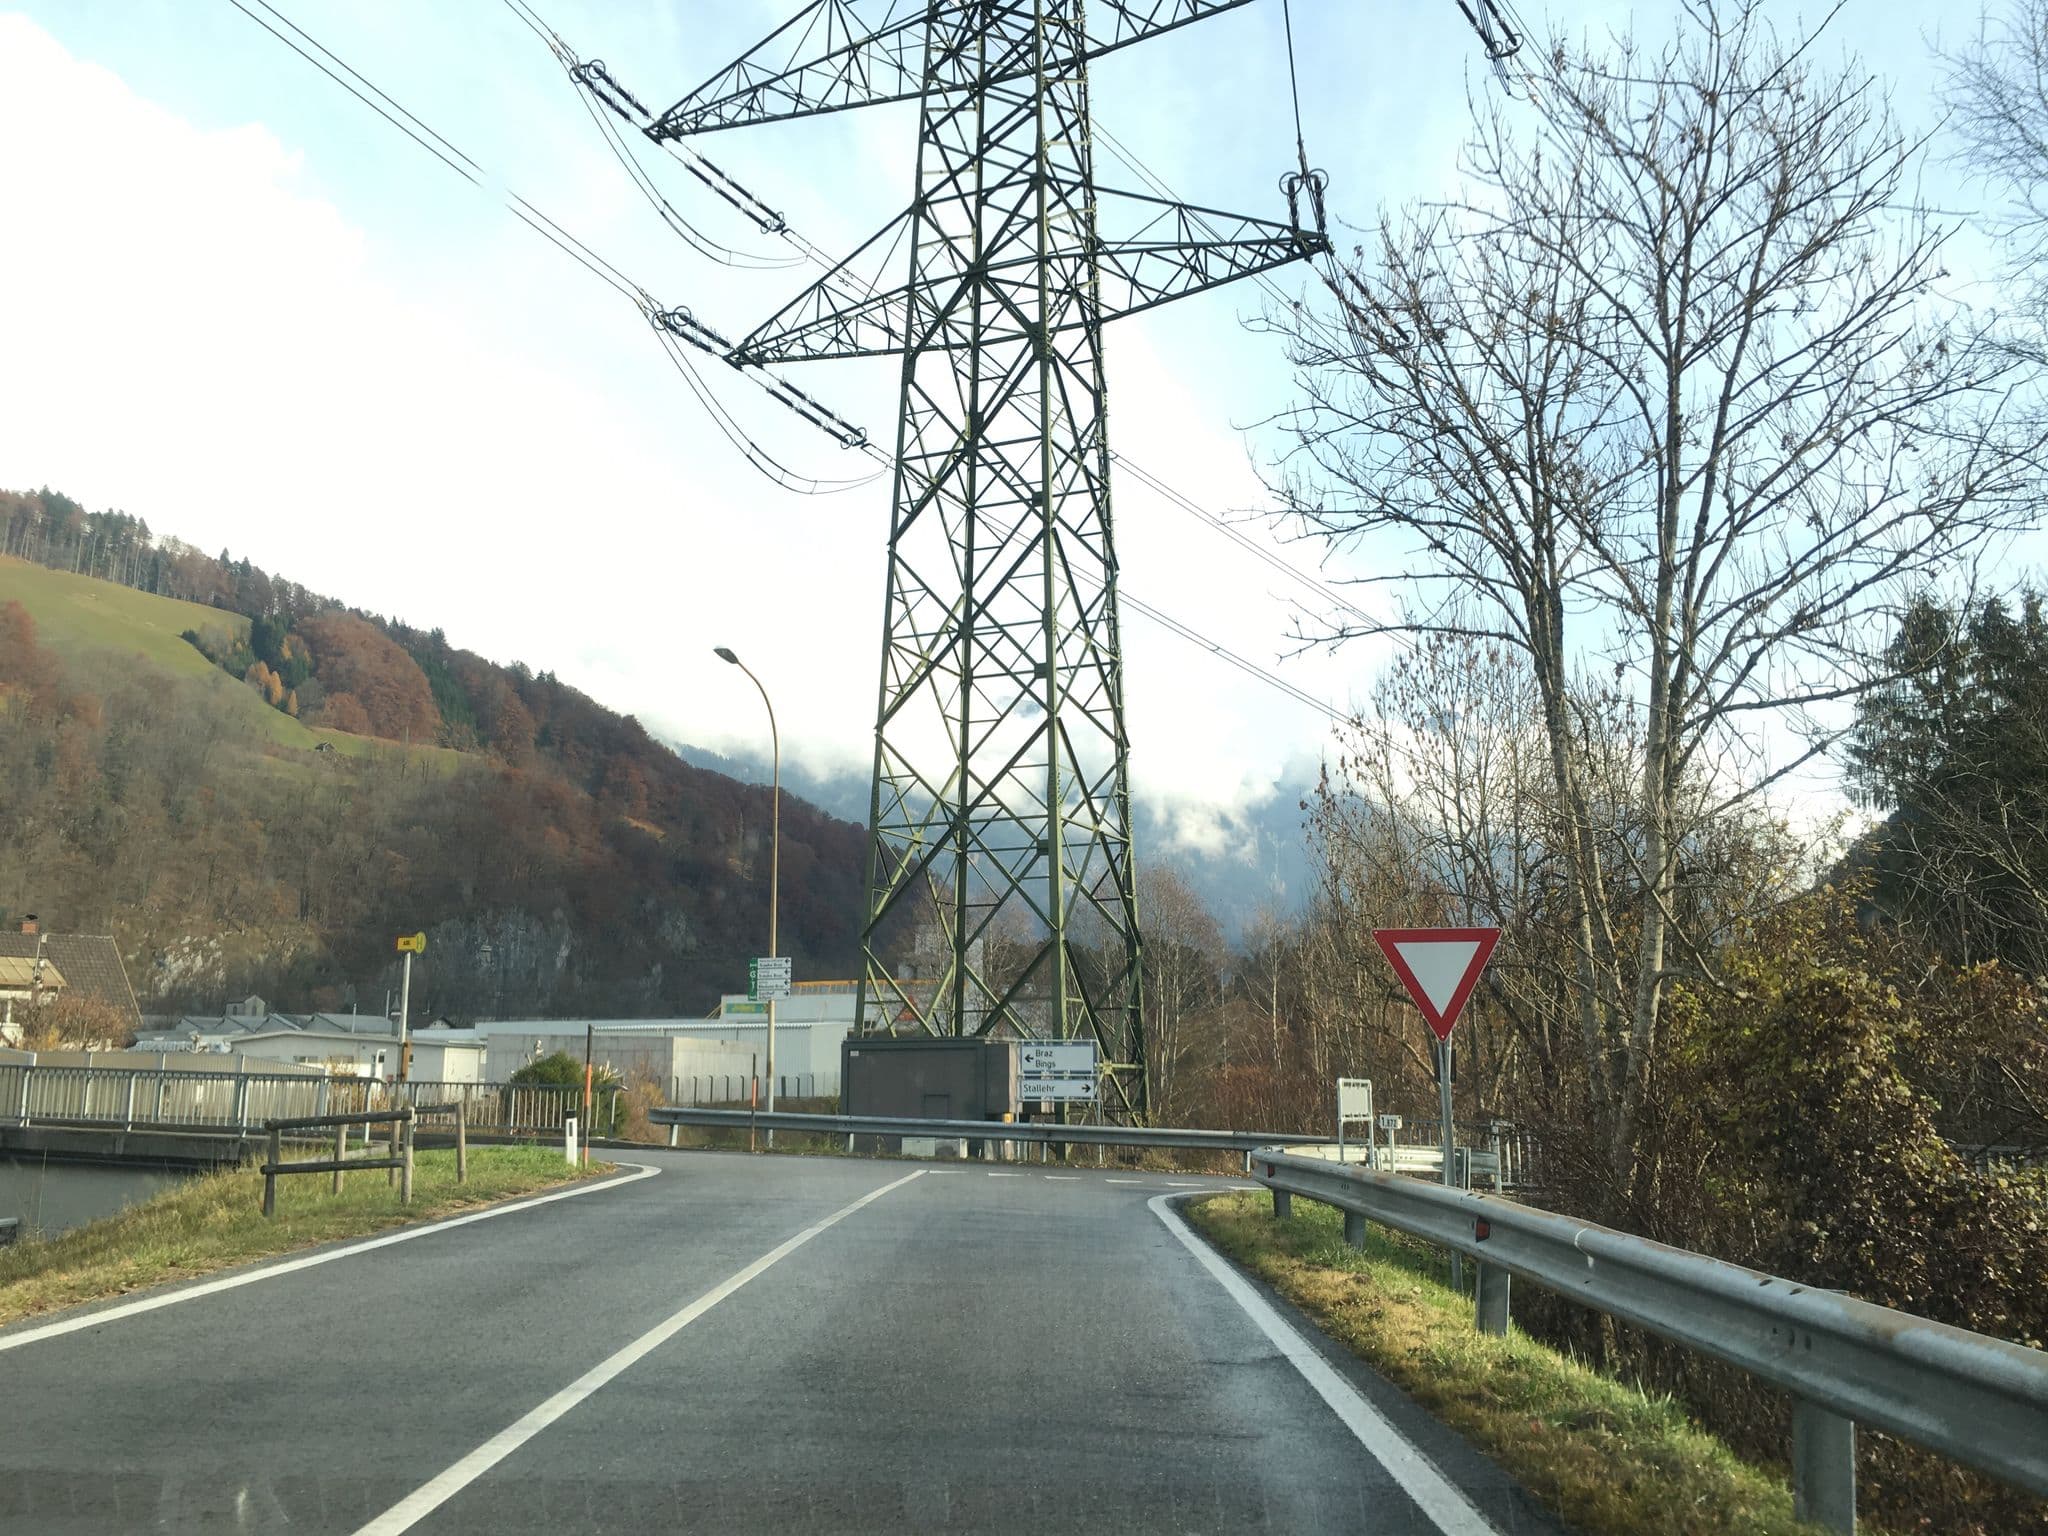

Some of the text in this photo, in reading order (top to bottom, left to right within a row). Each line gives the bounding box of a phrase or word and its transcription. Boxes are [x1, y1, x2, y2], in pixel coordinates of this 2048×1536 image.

[1035, 1049, 1053, 1057] Braz
[1035, 1060, 1056, 1069] Bings
[1023, 1084, 1055, 1093] Stallehr
